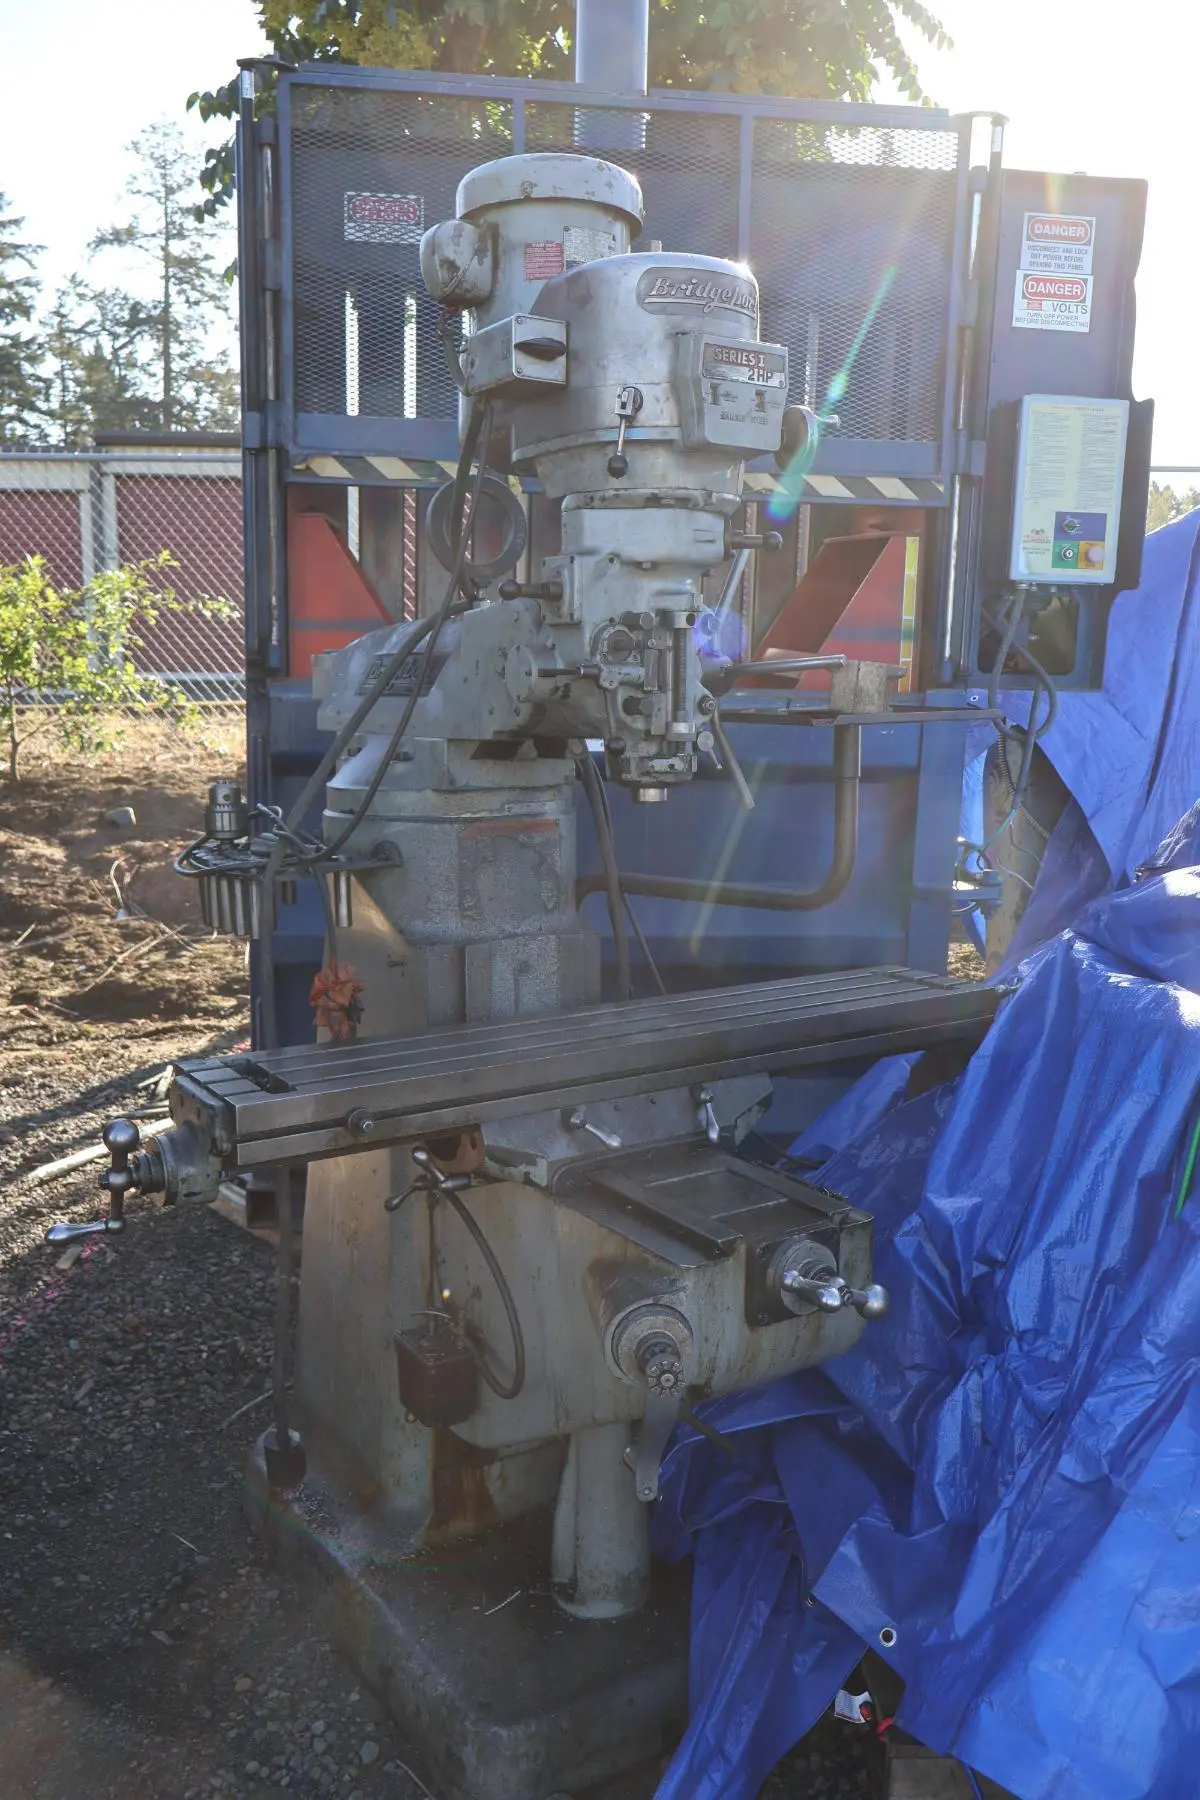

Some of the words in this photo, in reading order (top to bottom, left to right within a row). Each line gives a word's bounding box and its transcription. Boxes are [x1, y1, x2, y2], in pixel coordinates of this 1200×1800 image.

[1034, 223, 1085, 237] DANGER
[1027, 245, 1060, 253] DISCONNECT
[1043, 253, 1062, 261] POWER
[1063, 254, 1084, 262] BEFORE
[1028, 281, 1081, 295] DANGER
[1052, 302, 1088, 314] VOLTS
[713, 346, 754, 365] SERIES
[758, 354, 765, 367] I
[747, 367, 774, 384] 2HP
